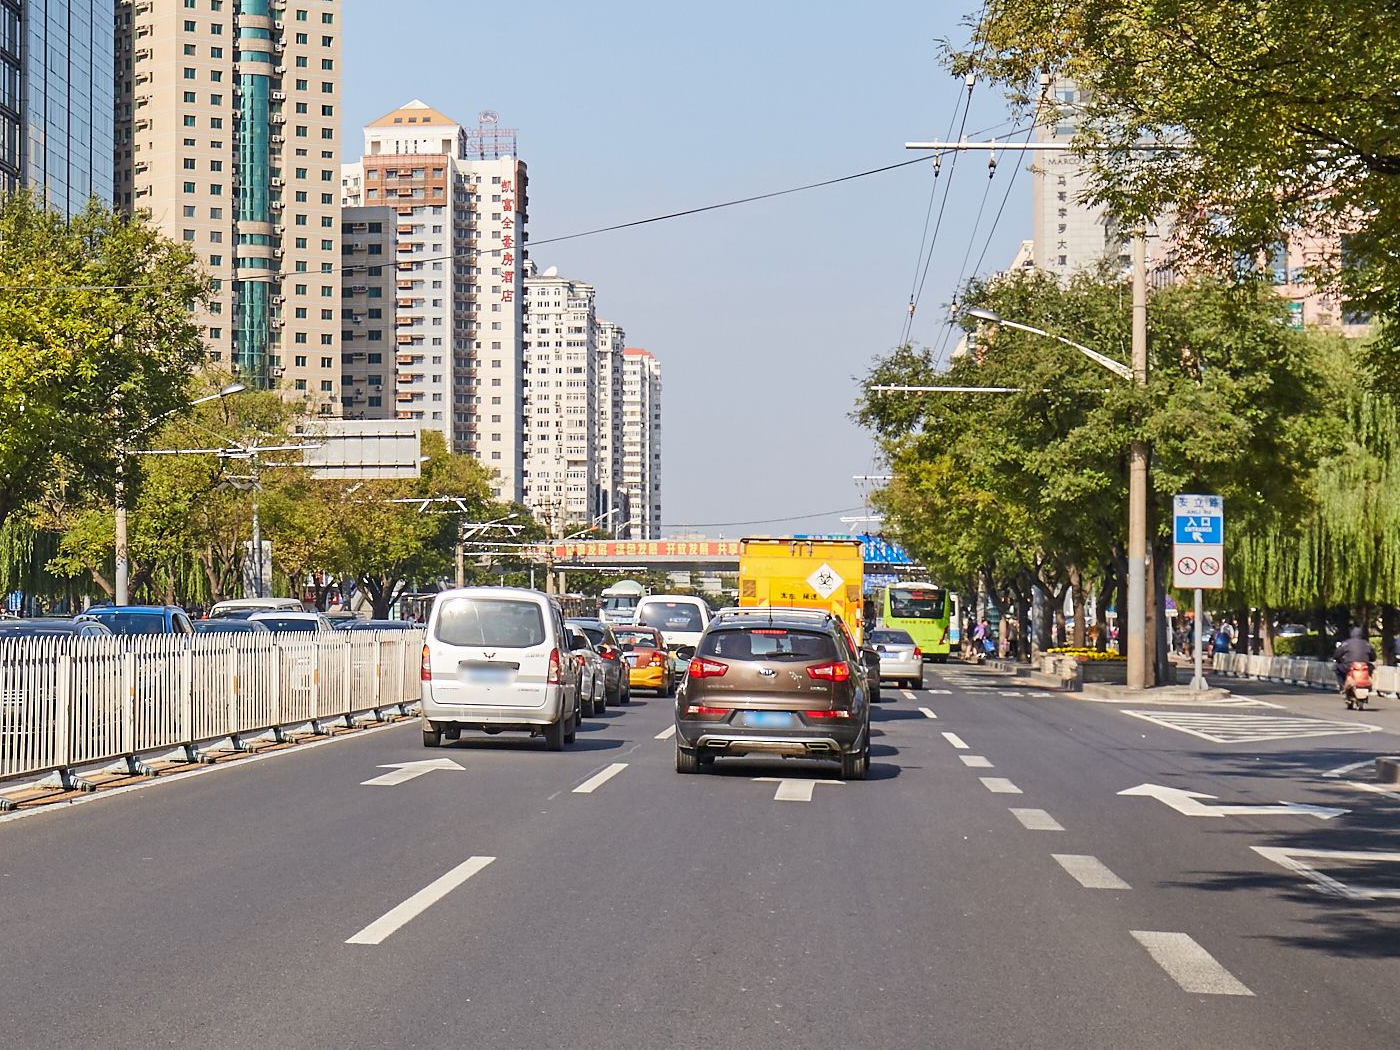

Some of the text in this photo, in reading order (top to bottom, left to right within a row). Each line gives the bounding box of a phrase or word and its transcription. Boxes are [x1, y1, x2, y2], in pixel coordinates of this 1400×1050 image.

[501, 180, 515, 303] 凯富全套房酒店
[1187, 517, 1211, 527] 入口
